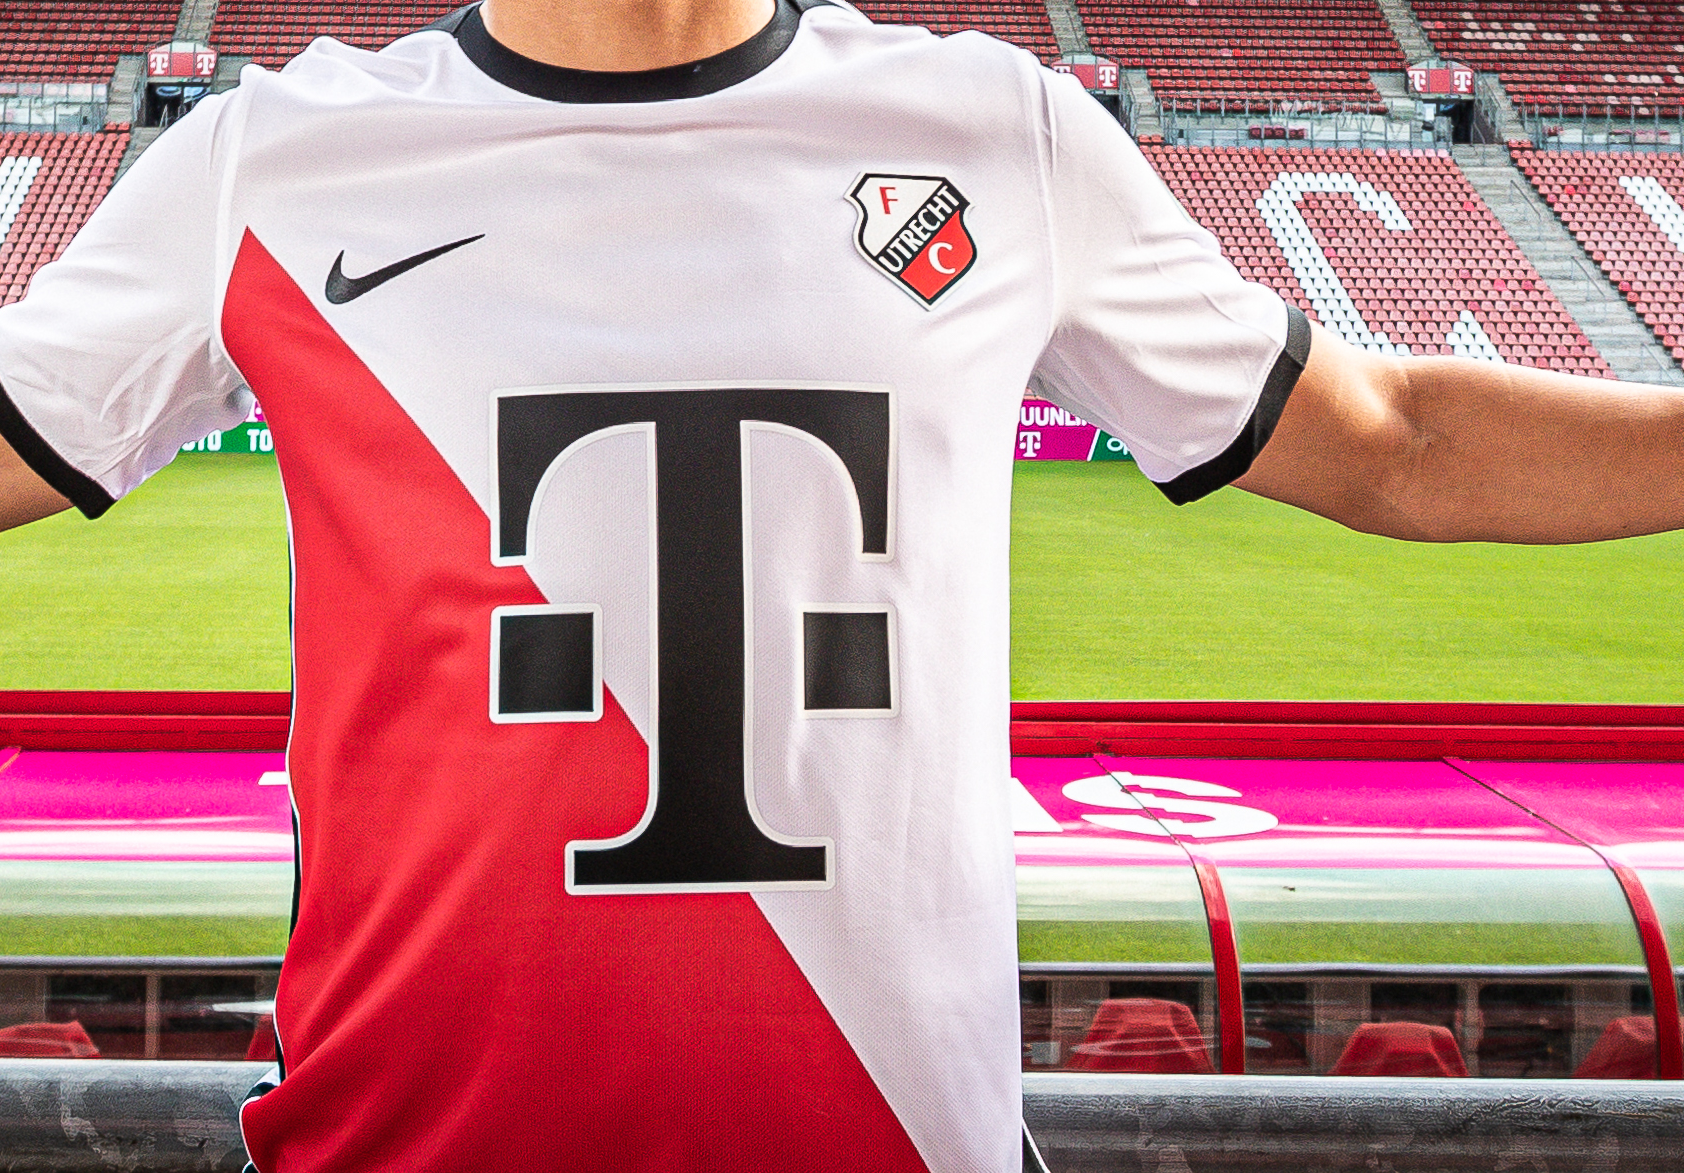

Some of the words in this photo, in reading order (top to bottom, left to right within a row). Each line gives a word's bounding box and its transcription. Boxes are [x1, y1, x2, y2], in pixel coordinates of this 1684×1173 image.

[149, 53, 169, 75] T
[197, 53, 215, 75] T
[1098, 66, 1117, 87] T
[1407, 70, 1426, 91] T
[1453, 71, 1472, 92] T
[879, 186, 899, 215] F
[877, 185, 961, 274] UTRECHT
[928, 241, 957, 275] C
[1019, 431, 1041, 457] T
[494, 387, 895, 891] T
